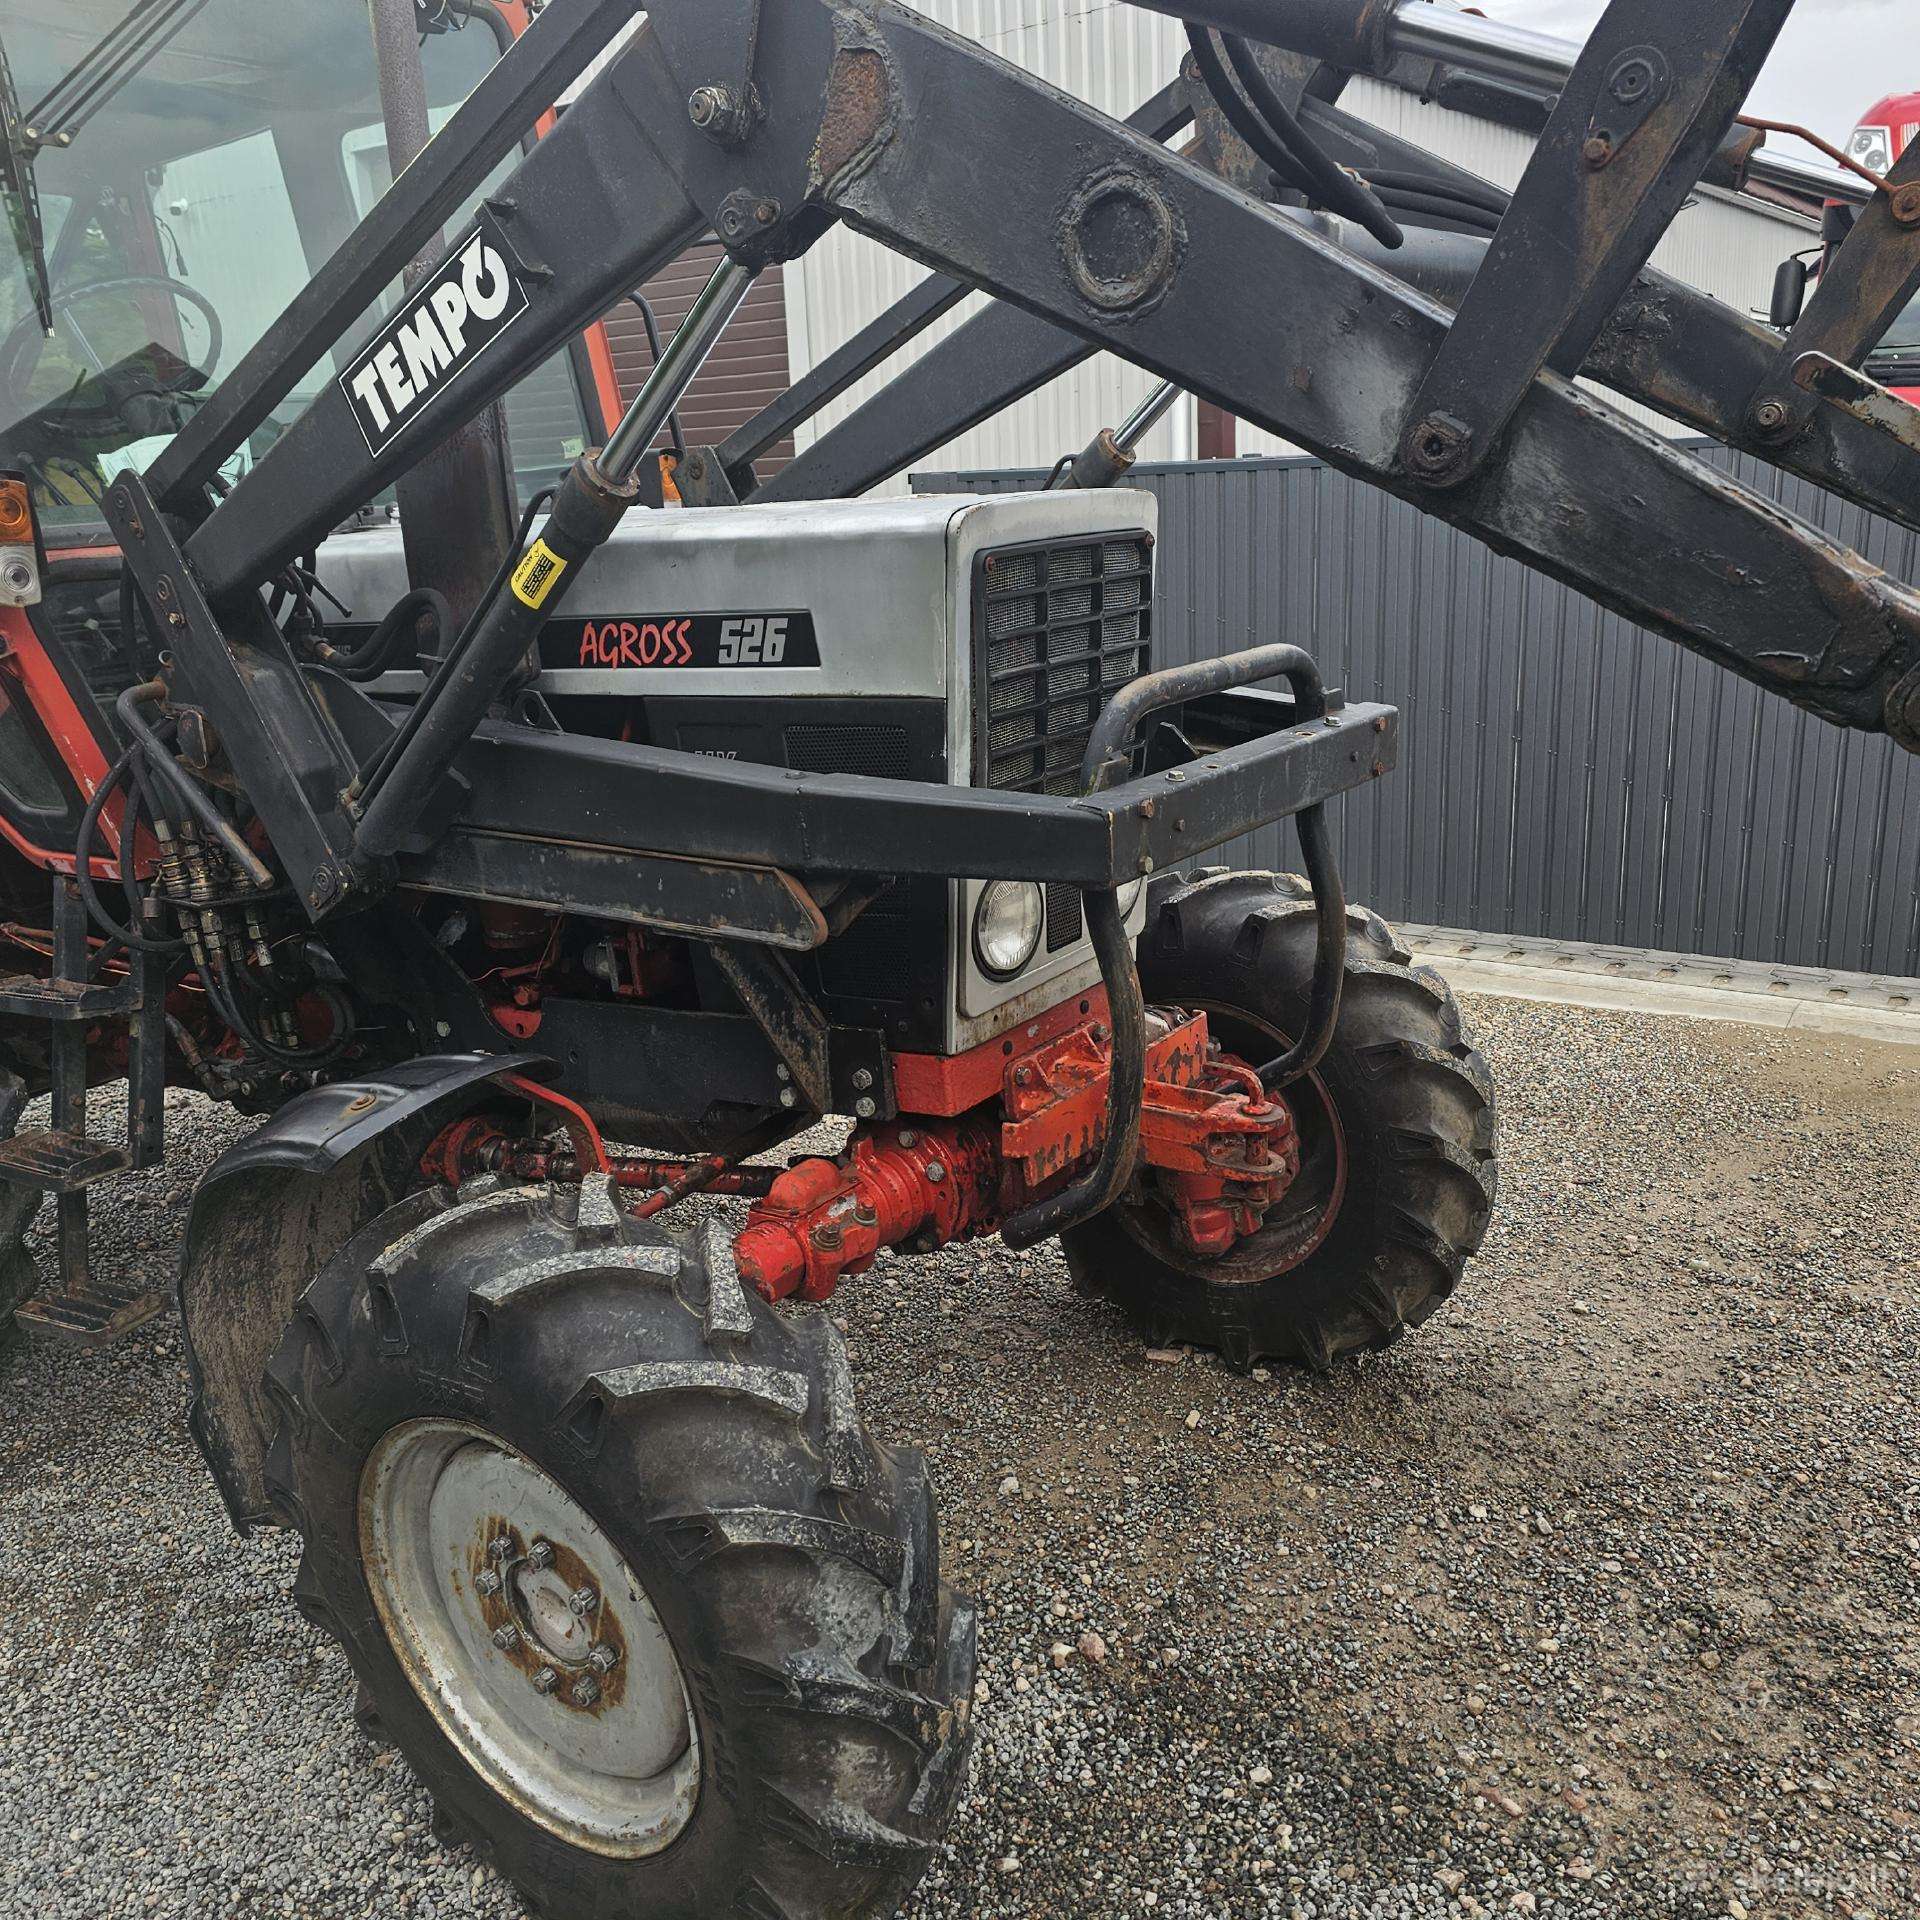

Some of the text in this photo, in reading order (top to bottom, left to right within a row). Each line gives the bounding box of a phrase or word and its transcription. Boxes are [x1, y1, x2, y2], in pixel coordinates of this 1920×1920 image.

[352, 236, 509, 432] TEMPO
[580, 617, 789, 669] AGROSS 526
